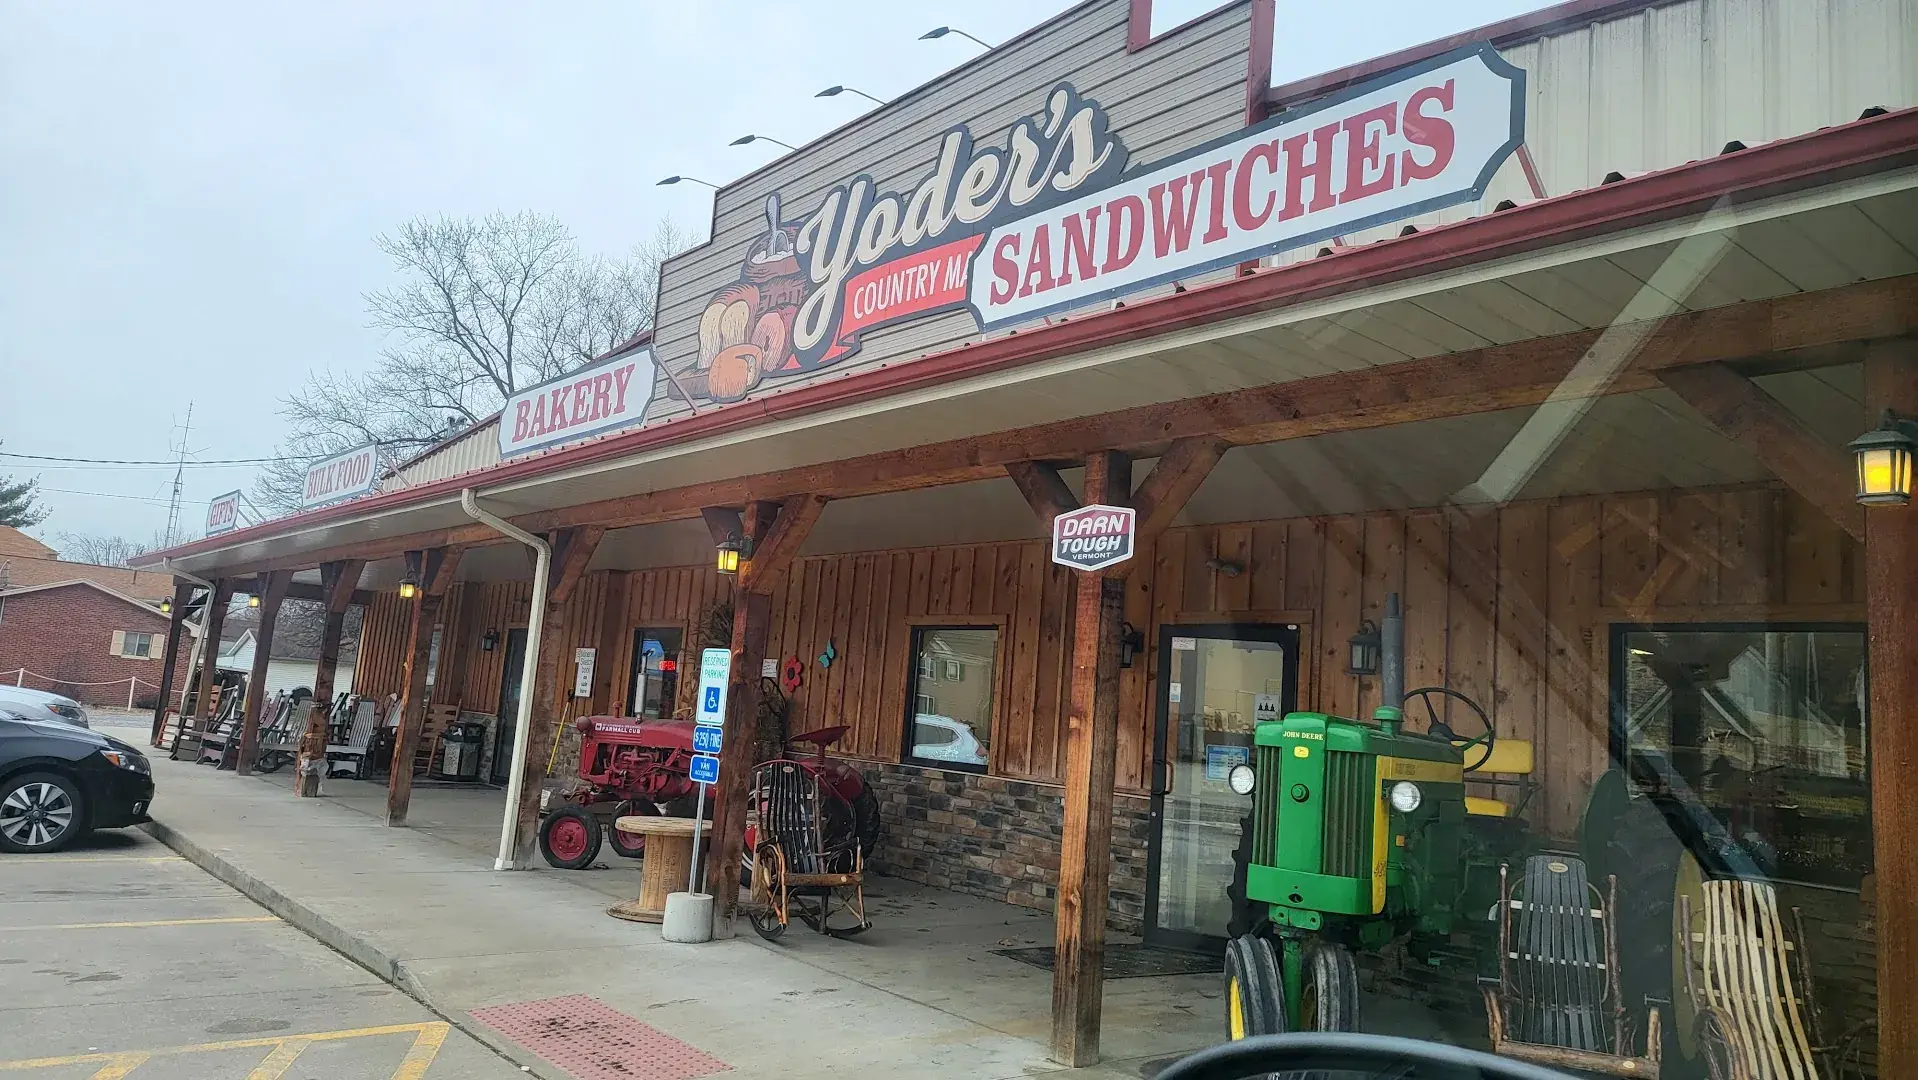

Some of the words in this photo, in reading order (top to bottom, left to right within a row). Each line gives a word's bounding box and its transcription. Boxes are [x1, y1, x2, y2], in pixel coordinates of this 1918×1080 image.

[989, 78, 1456, 306] SANDWICHES
[793, 89, 1114, 350] Yoder's
[853, 259, 942, 320] COUNTRY
[511, 362, 636, 444] BAKERY
[305, 460, 338, 500] BULK
[334, 452, 371, 491] FOOD
[209, 497, 236, 528] GIFTS
[1062, 513, 1126, 537] DARN
[1060, 535, 1122, 554] TOUGH
[1071, 552, 1112, 560] VERMONT
[659, 660, 676, 671] OPEN
[704, 656, 728, 667] RESERVED
[704, 669, 725, 679] PARKING
[710, 732, 722, 748] FINE
[1282, 730, 1300, 739] JOHN
[1301, 732, 1324, 741] DEERE
[700, 761, 711, 771] VAN
